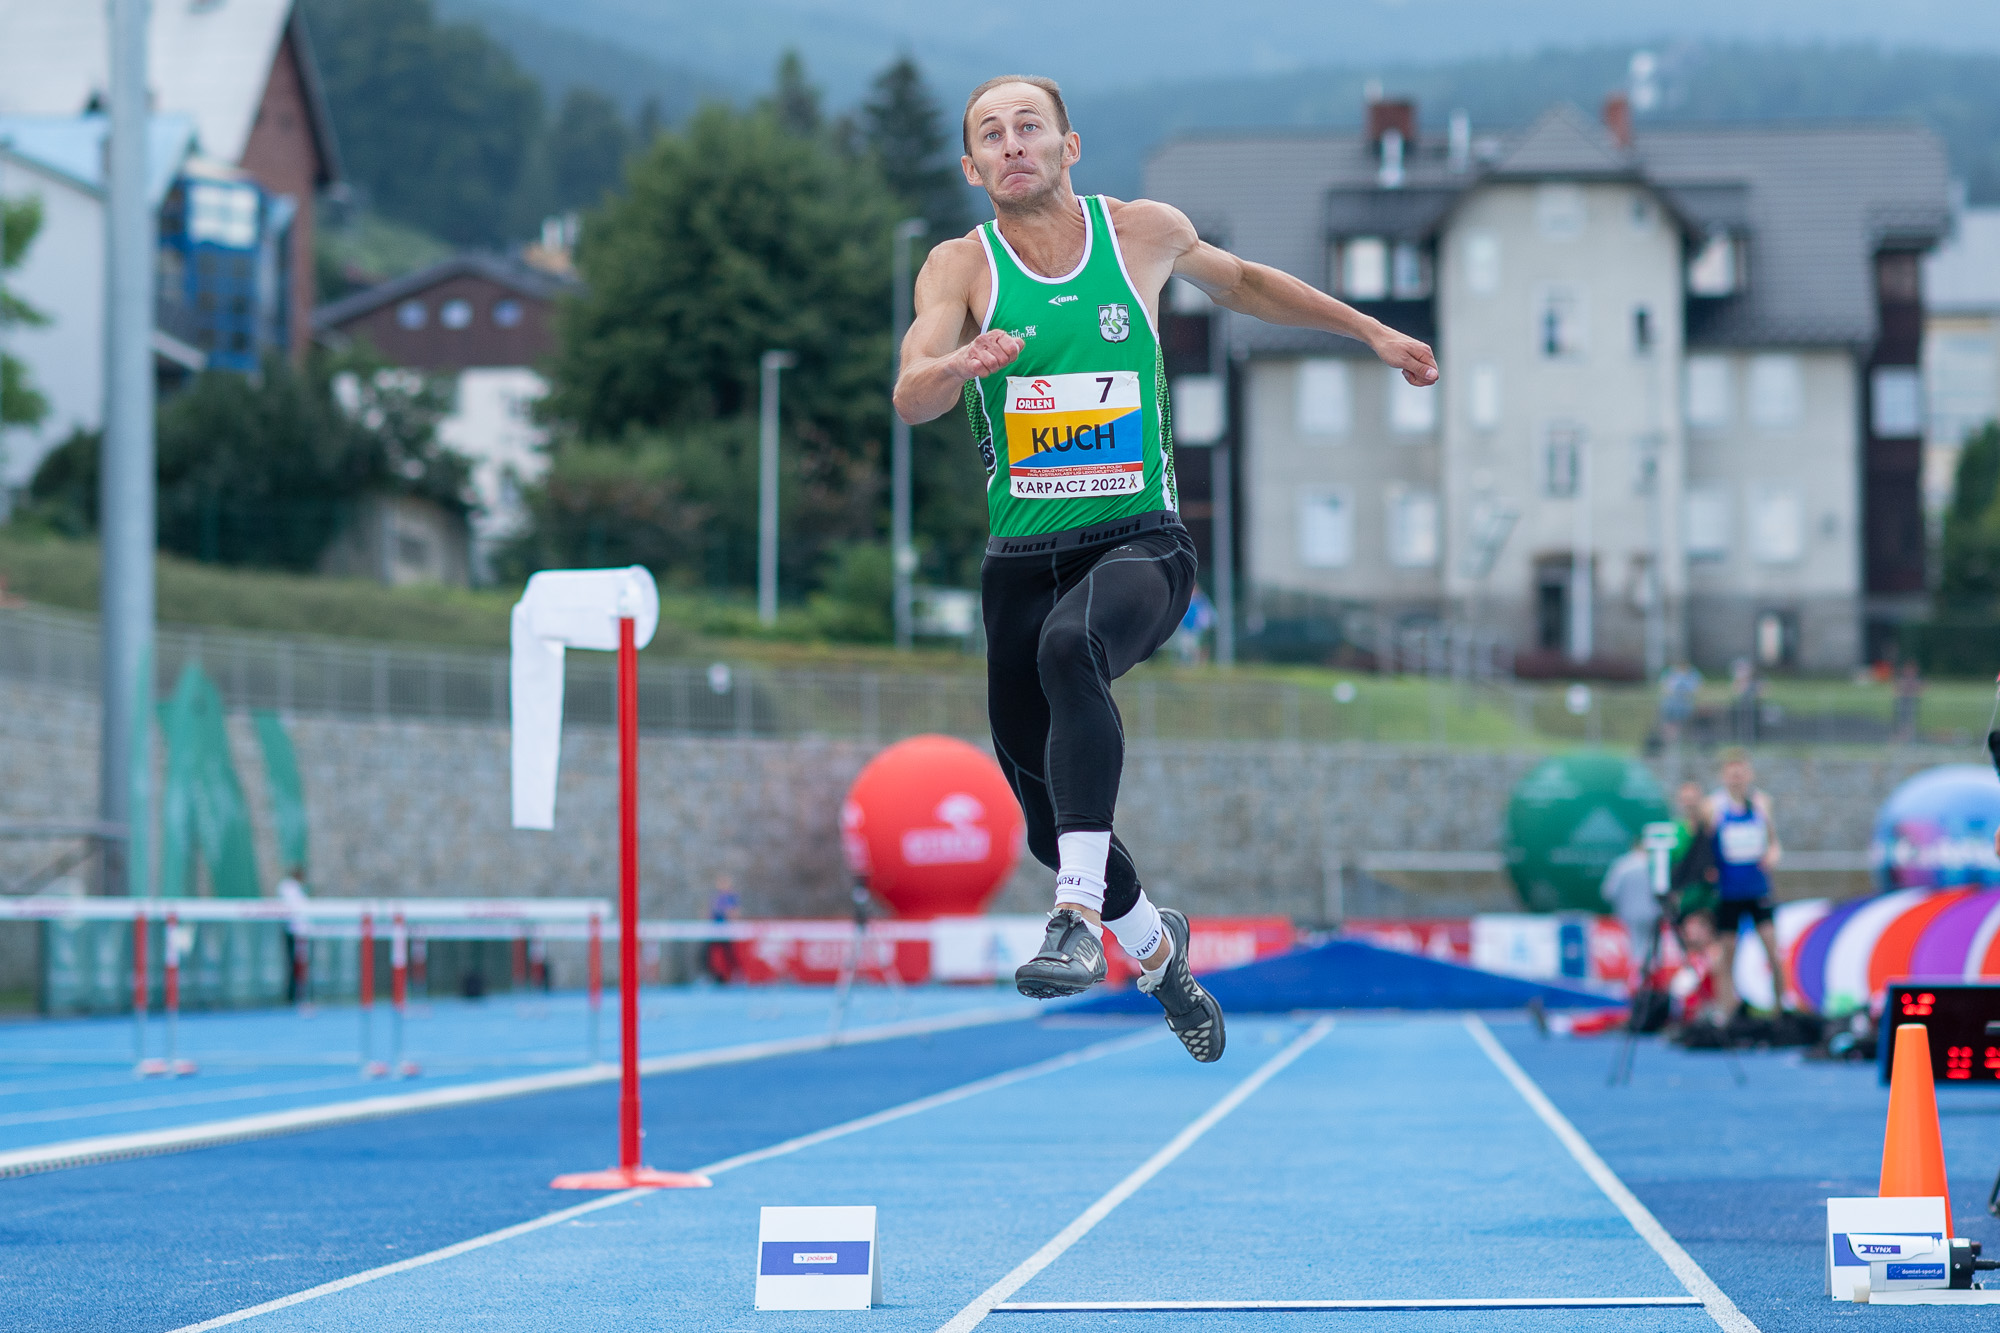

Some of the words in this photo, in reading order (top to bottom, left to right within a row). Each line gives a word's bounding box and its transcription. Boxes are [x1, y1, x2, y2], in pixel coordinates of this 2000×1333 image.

[1058, 295, 1078, 303] IBRA
[1096, 377, 1113, 403] 7
[1018, 398, 1053, 409] ORLEN
[1031, 423, 1116, 453] KUCH
[1017, 480, 1086, 494] KARPACZ
[1091, 478, 1126, 491] 2022
[1870, 1245, 1892, 1254] LYNX
